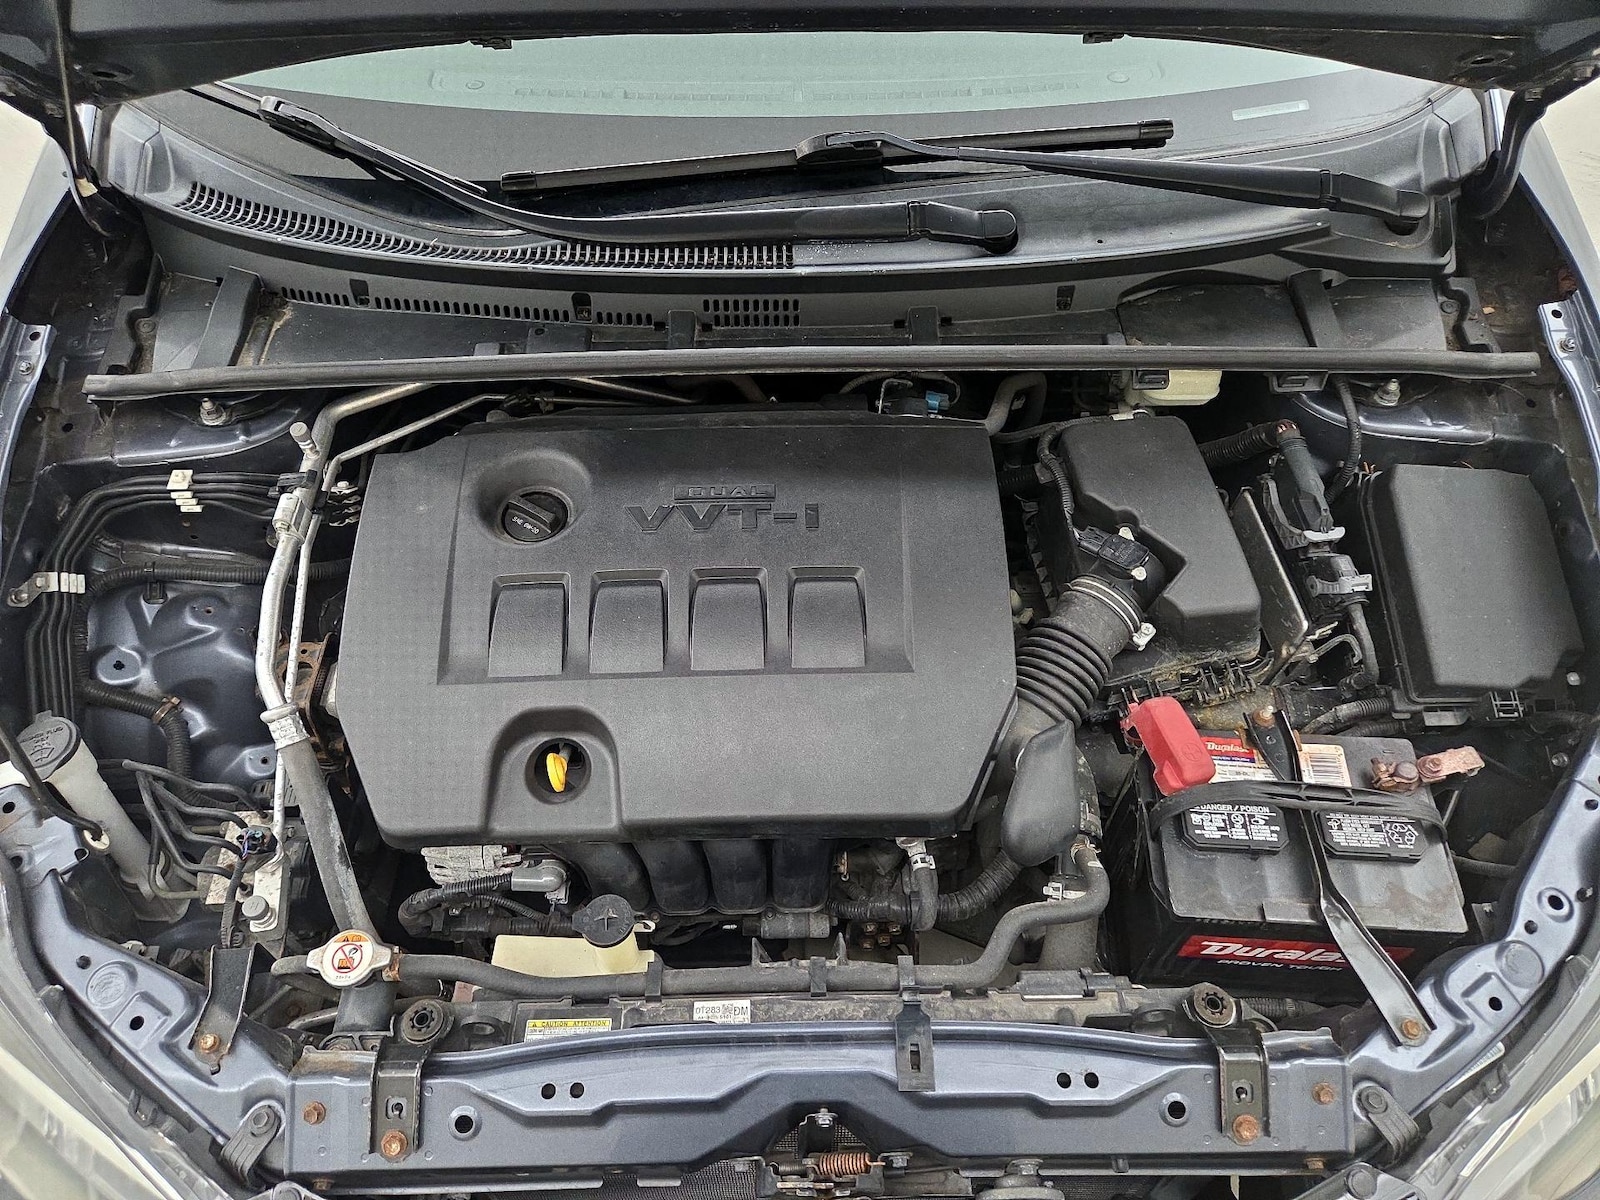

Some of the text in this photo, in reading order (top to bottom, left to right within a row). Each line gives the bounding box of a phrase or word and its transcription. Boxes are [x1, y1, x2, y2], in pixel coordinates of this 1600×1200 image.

[688, 486, 768, 497] DUAL
[1240, 805, 1270, 813] POISON
[1217, 959, 1344, 972] PROVEN TOUGH
